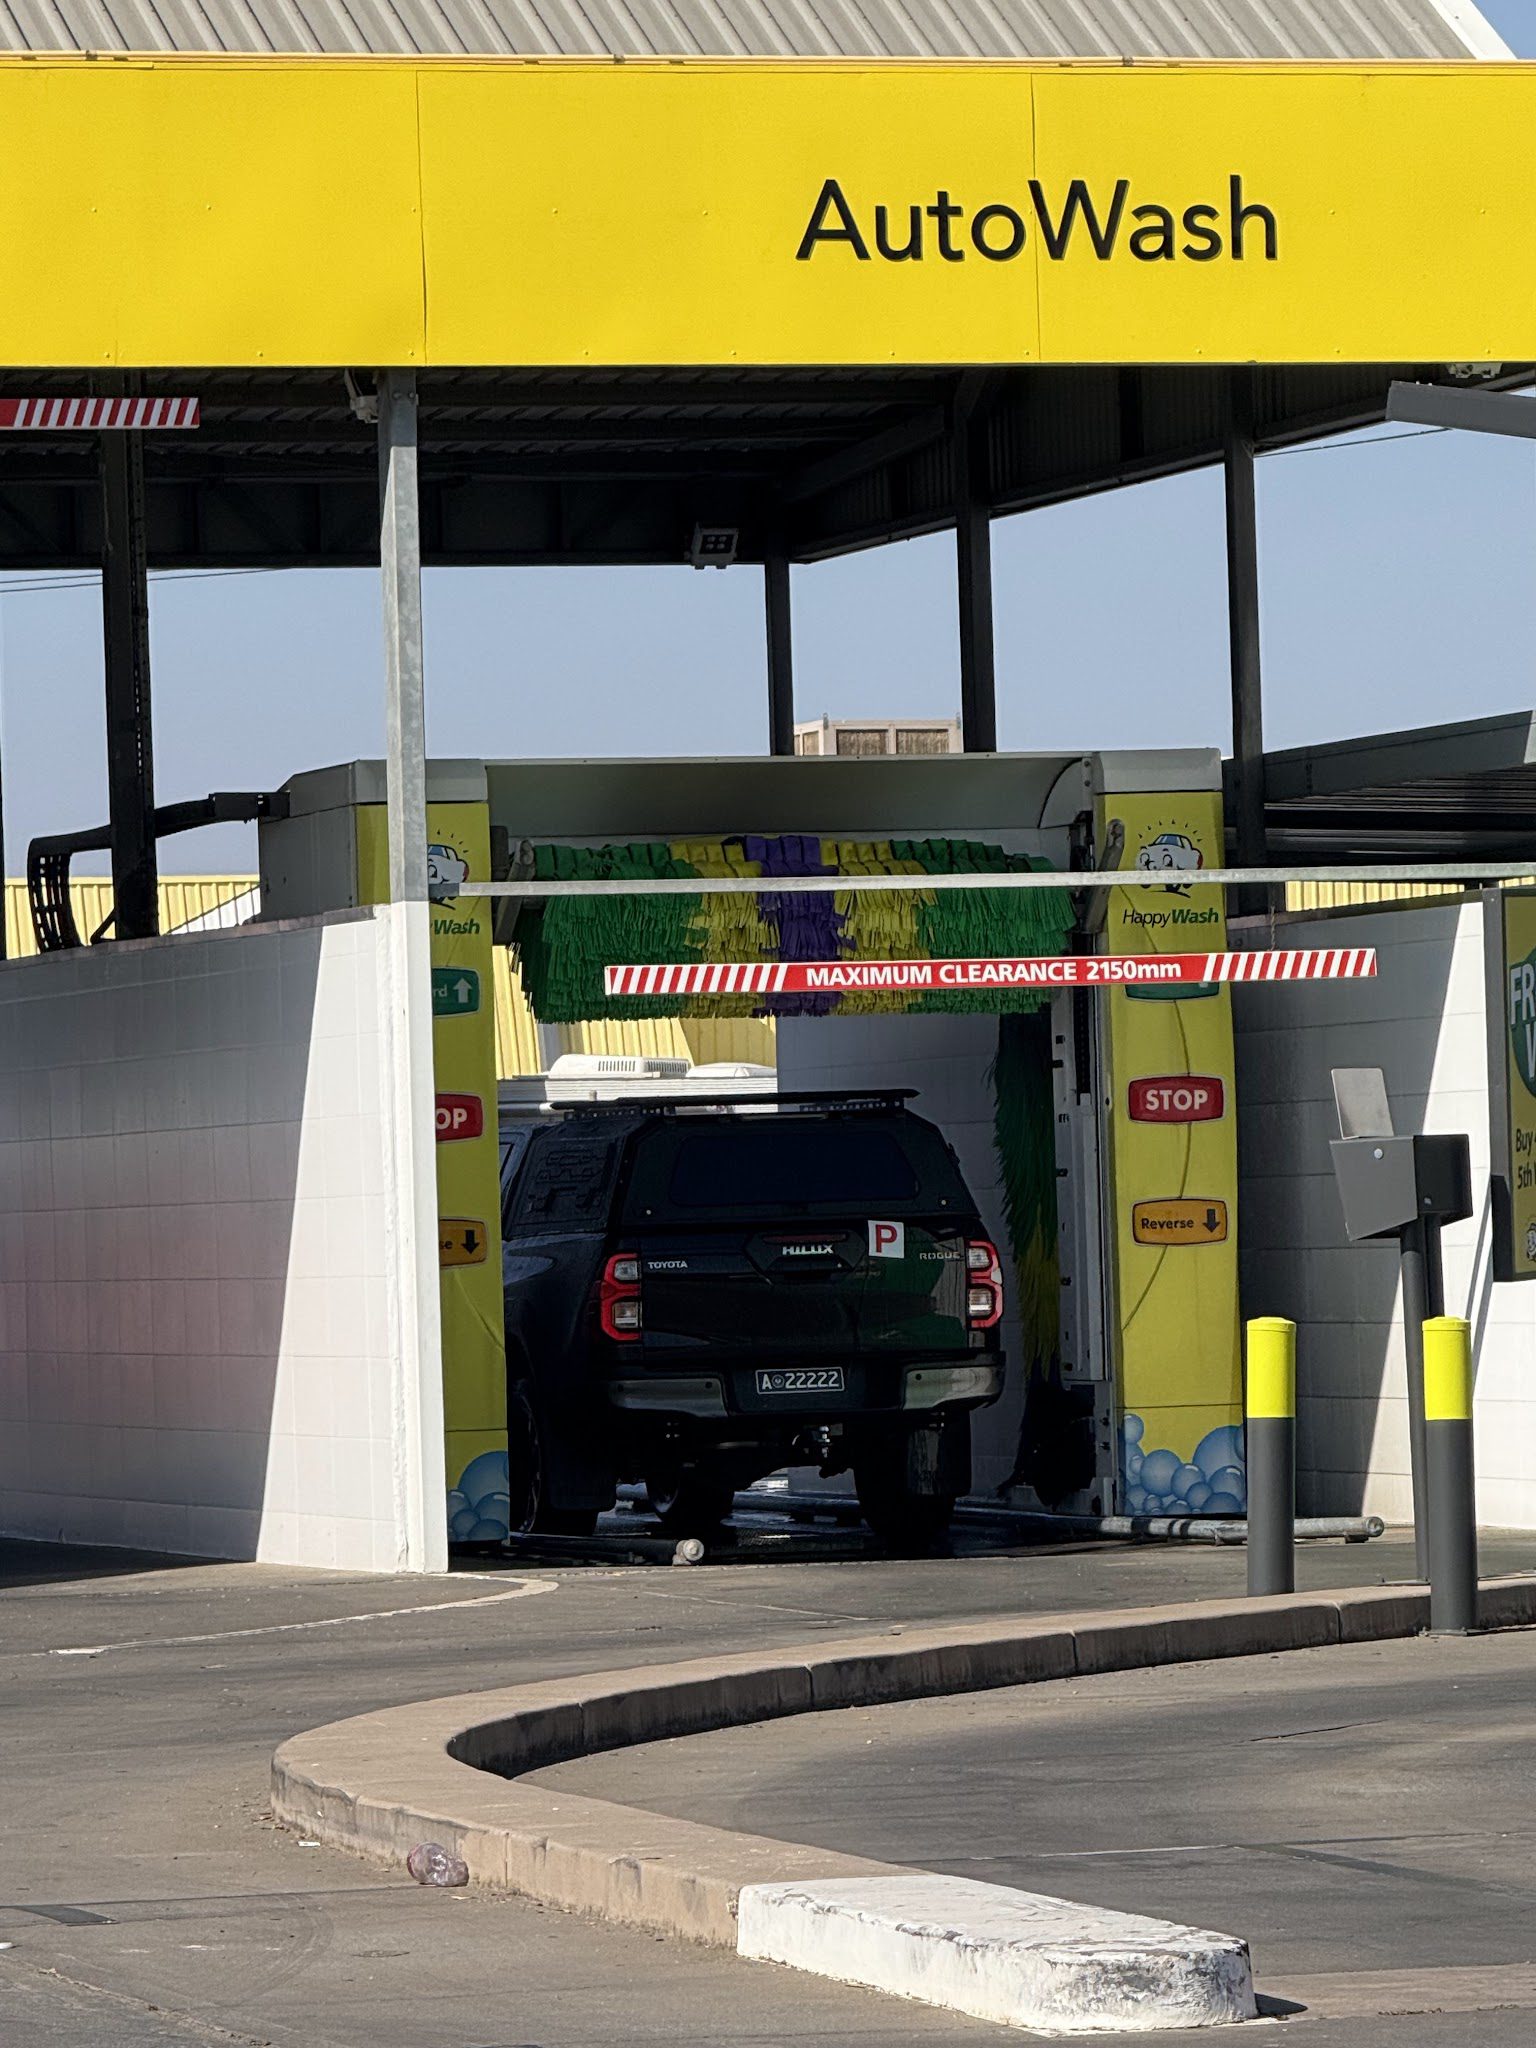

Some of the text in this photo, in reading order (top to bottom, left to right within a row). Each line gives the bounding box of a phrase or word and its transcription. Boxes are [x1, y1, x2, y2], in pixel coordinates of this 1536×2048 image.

[796, 174, 1278, 261] AutoWash
[431, 918, 480, 935] Wash
[805, 960, 1182, 987] MAXIMUM CLEARANCE 2150mm
[1510, 963, 1536, 1025] FR
[1145, 1089, 1209, 1111] STOP
[436, 1107, 468, 1129] OP
[1516, 1128, 1533, 1156] Buy
[1517, 1165, 1532, 1190] 5th
[1141, 1218, 1194, 1230] Reverse
[875, 1224, 898, 1253] P
[782, 1244, 834, 1256] HILUX
[919, 1251, 961, 1260] ROGUE
[648, 1260, 688, 1270] TOYOTA
